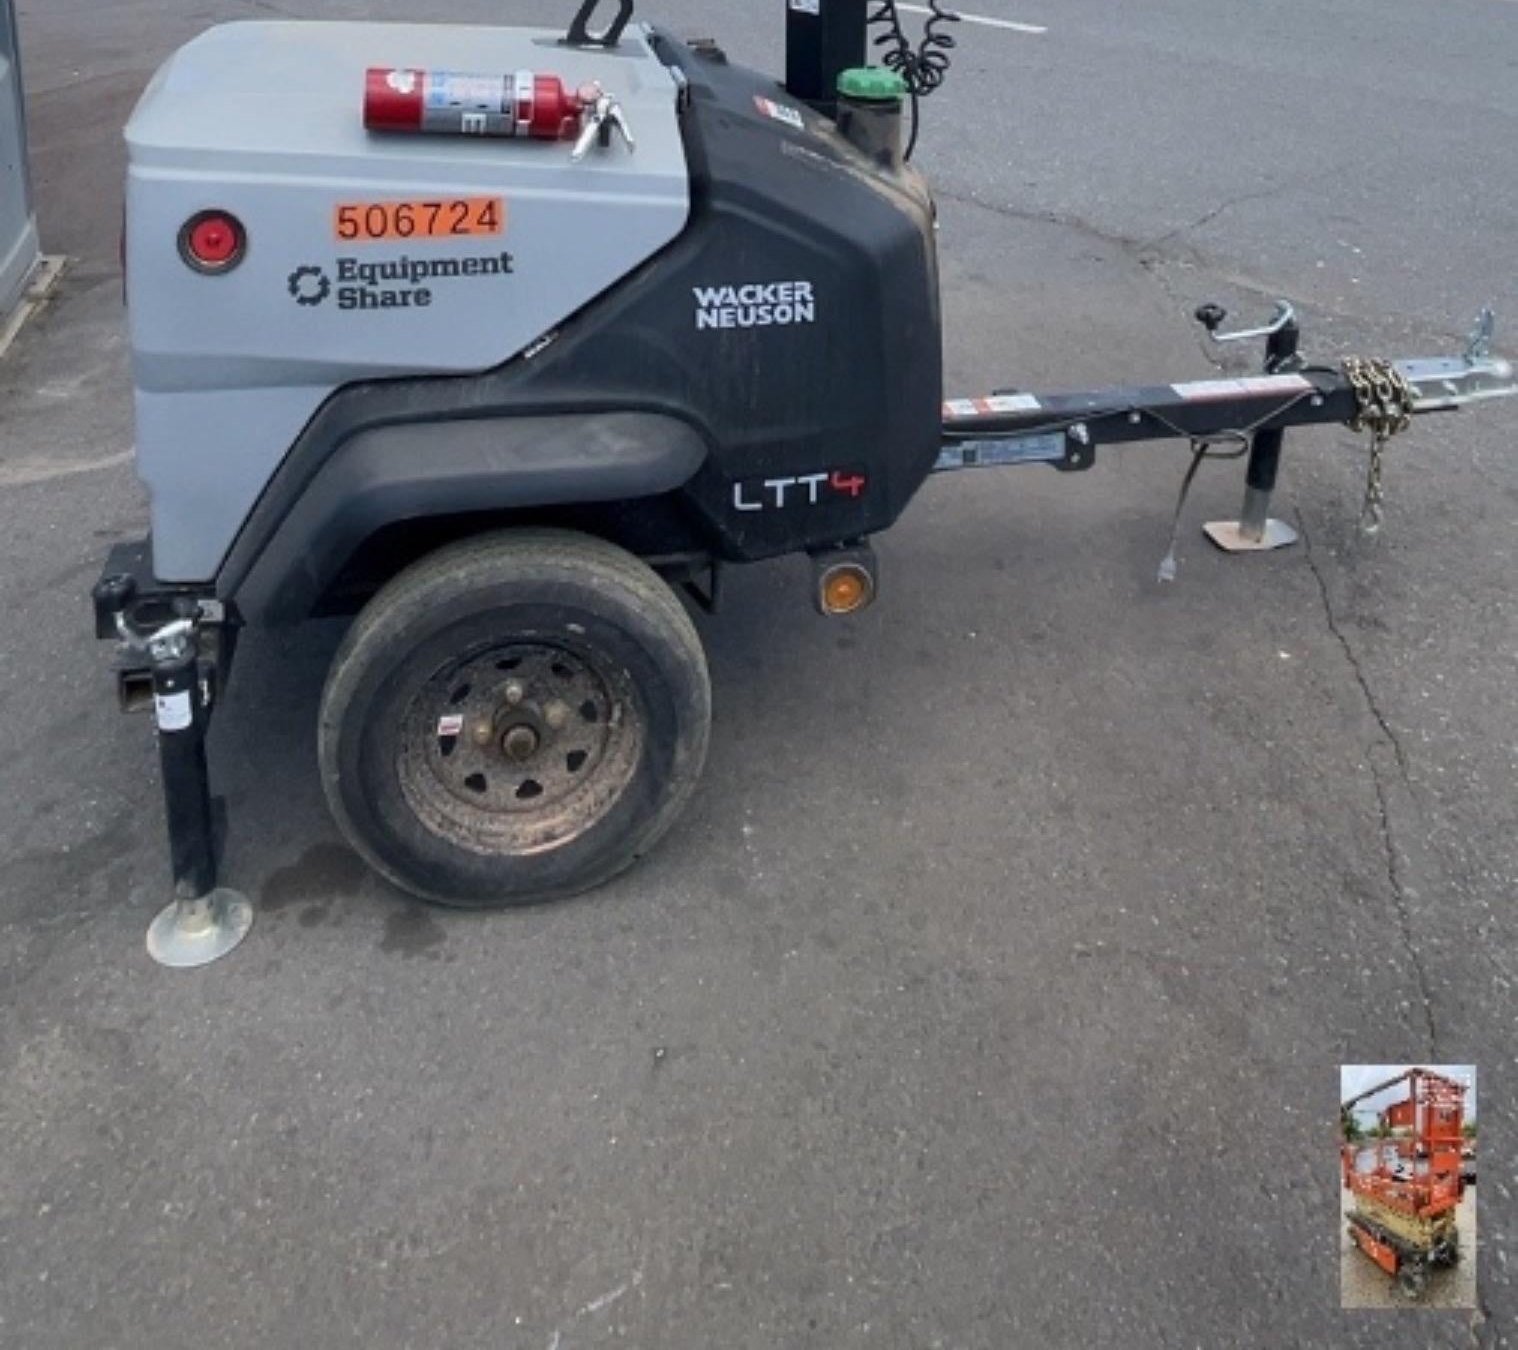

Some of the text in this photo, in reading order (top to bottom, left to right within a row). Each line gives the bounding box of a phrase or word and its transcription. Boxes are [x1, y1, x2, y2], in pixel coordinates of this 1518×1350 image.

[337, 200, 499, 239] 506724
[335, 251, 514, 286] Equipment
[337, 286, 433, 310] Share
[692, 281, 815, 307] WACKER
[695, 301, 815, 330] NEUSON
[734, 471, 865, 510] LTT4
